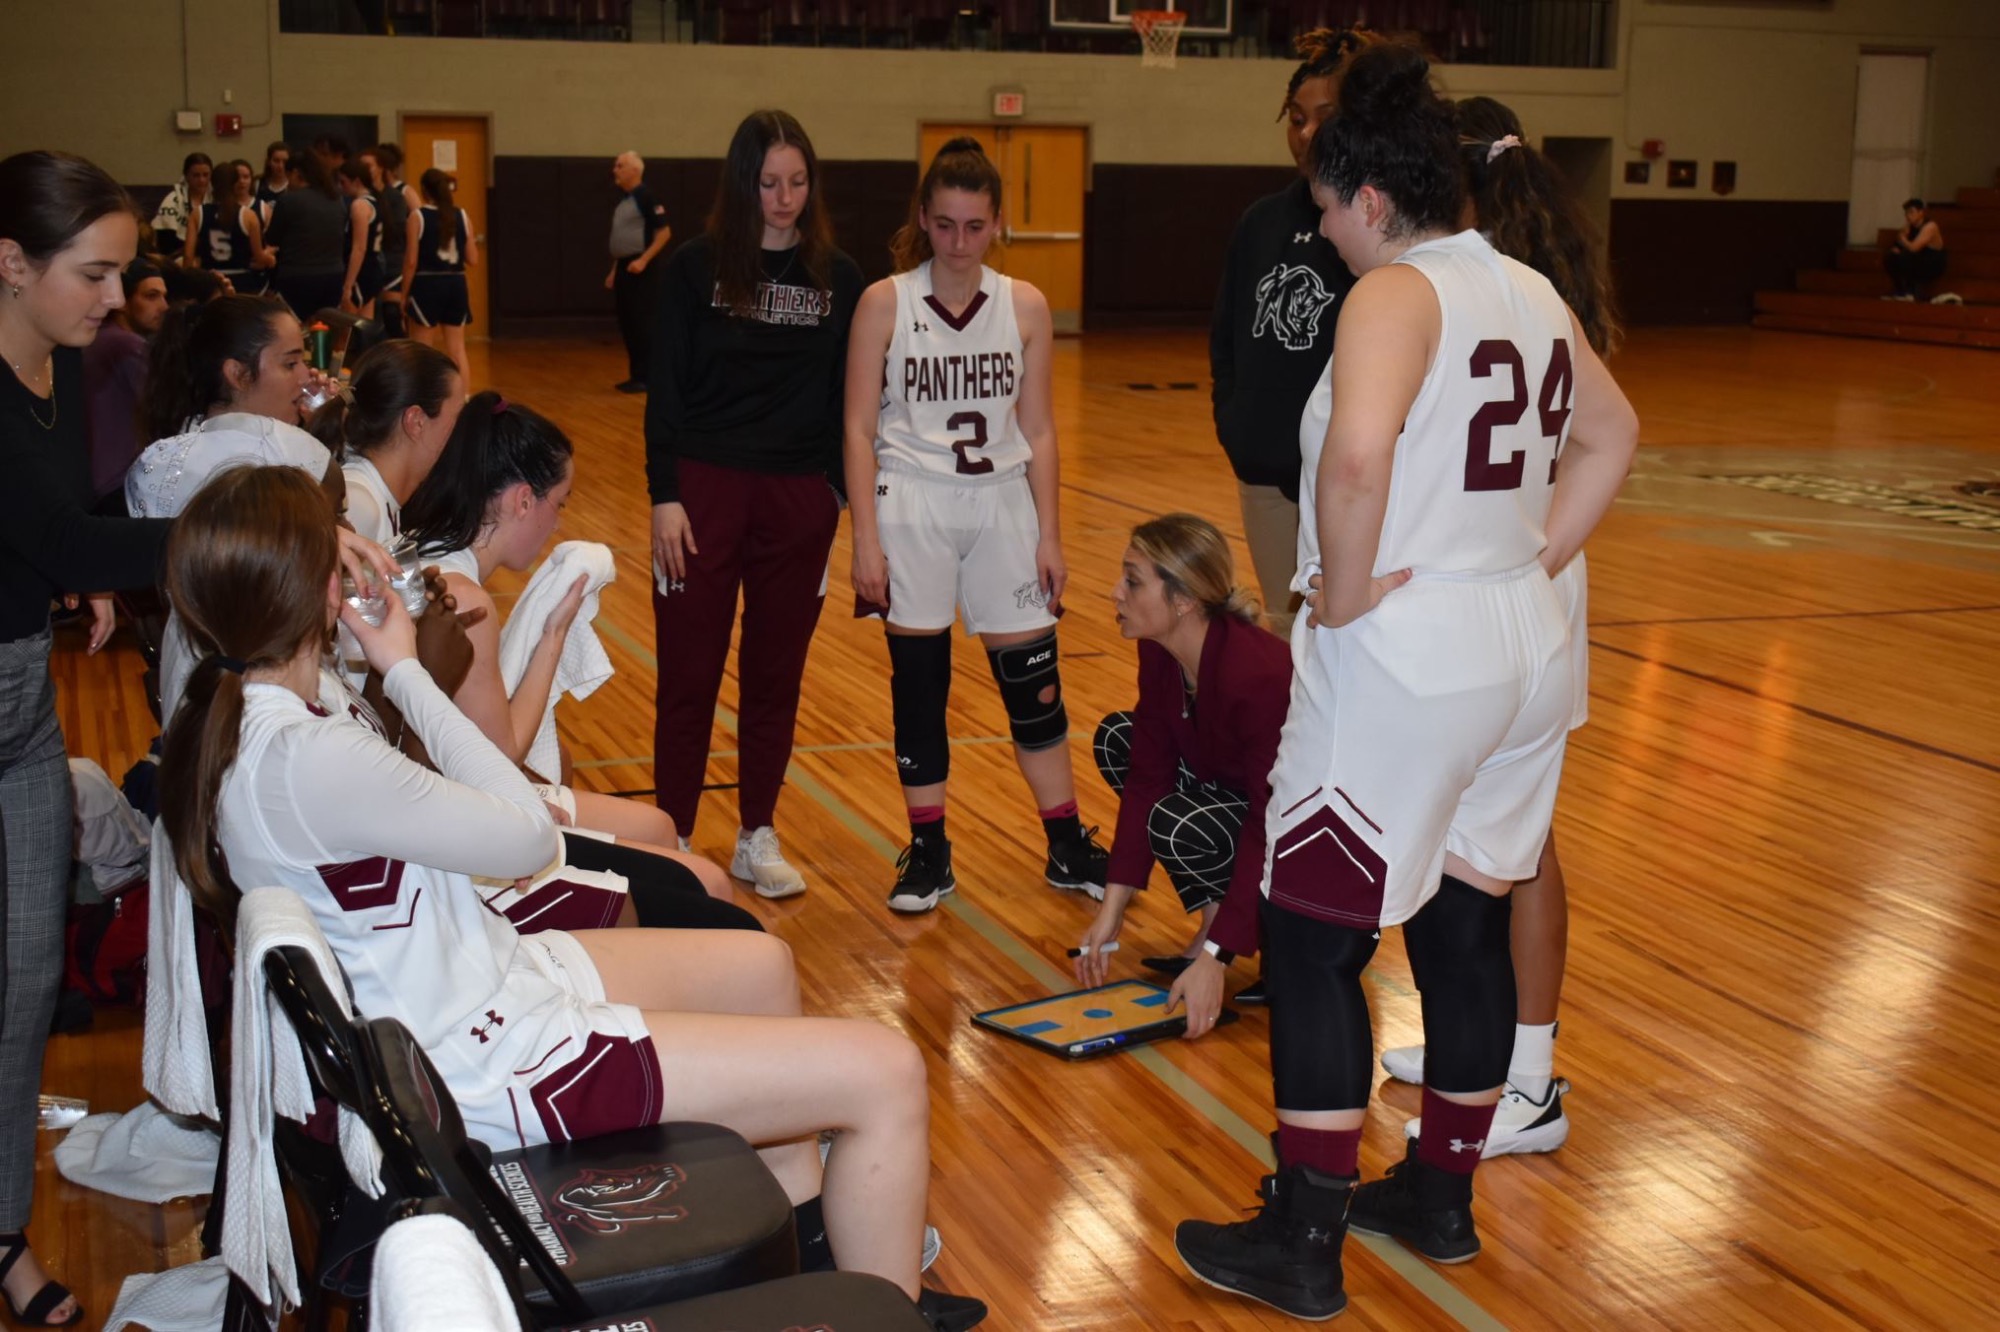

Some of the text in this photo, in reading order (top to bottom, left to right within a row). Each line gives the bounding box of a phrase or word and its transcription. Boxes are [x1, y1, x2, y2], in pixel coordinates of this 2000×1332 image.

[209, 229, 232, 261] 5
[905, 352, 1014, 402] PANTHERS
[1463, 338, 1573, 492] 24
[946, 411, 994, 475] 2
[1026, 649, 1052, 666] ACE
[498, 1161, 530, 1190] SCIENCES
[511, 1188, 543, 1215] HEALTH
